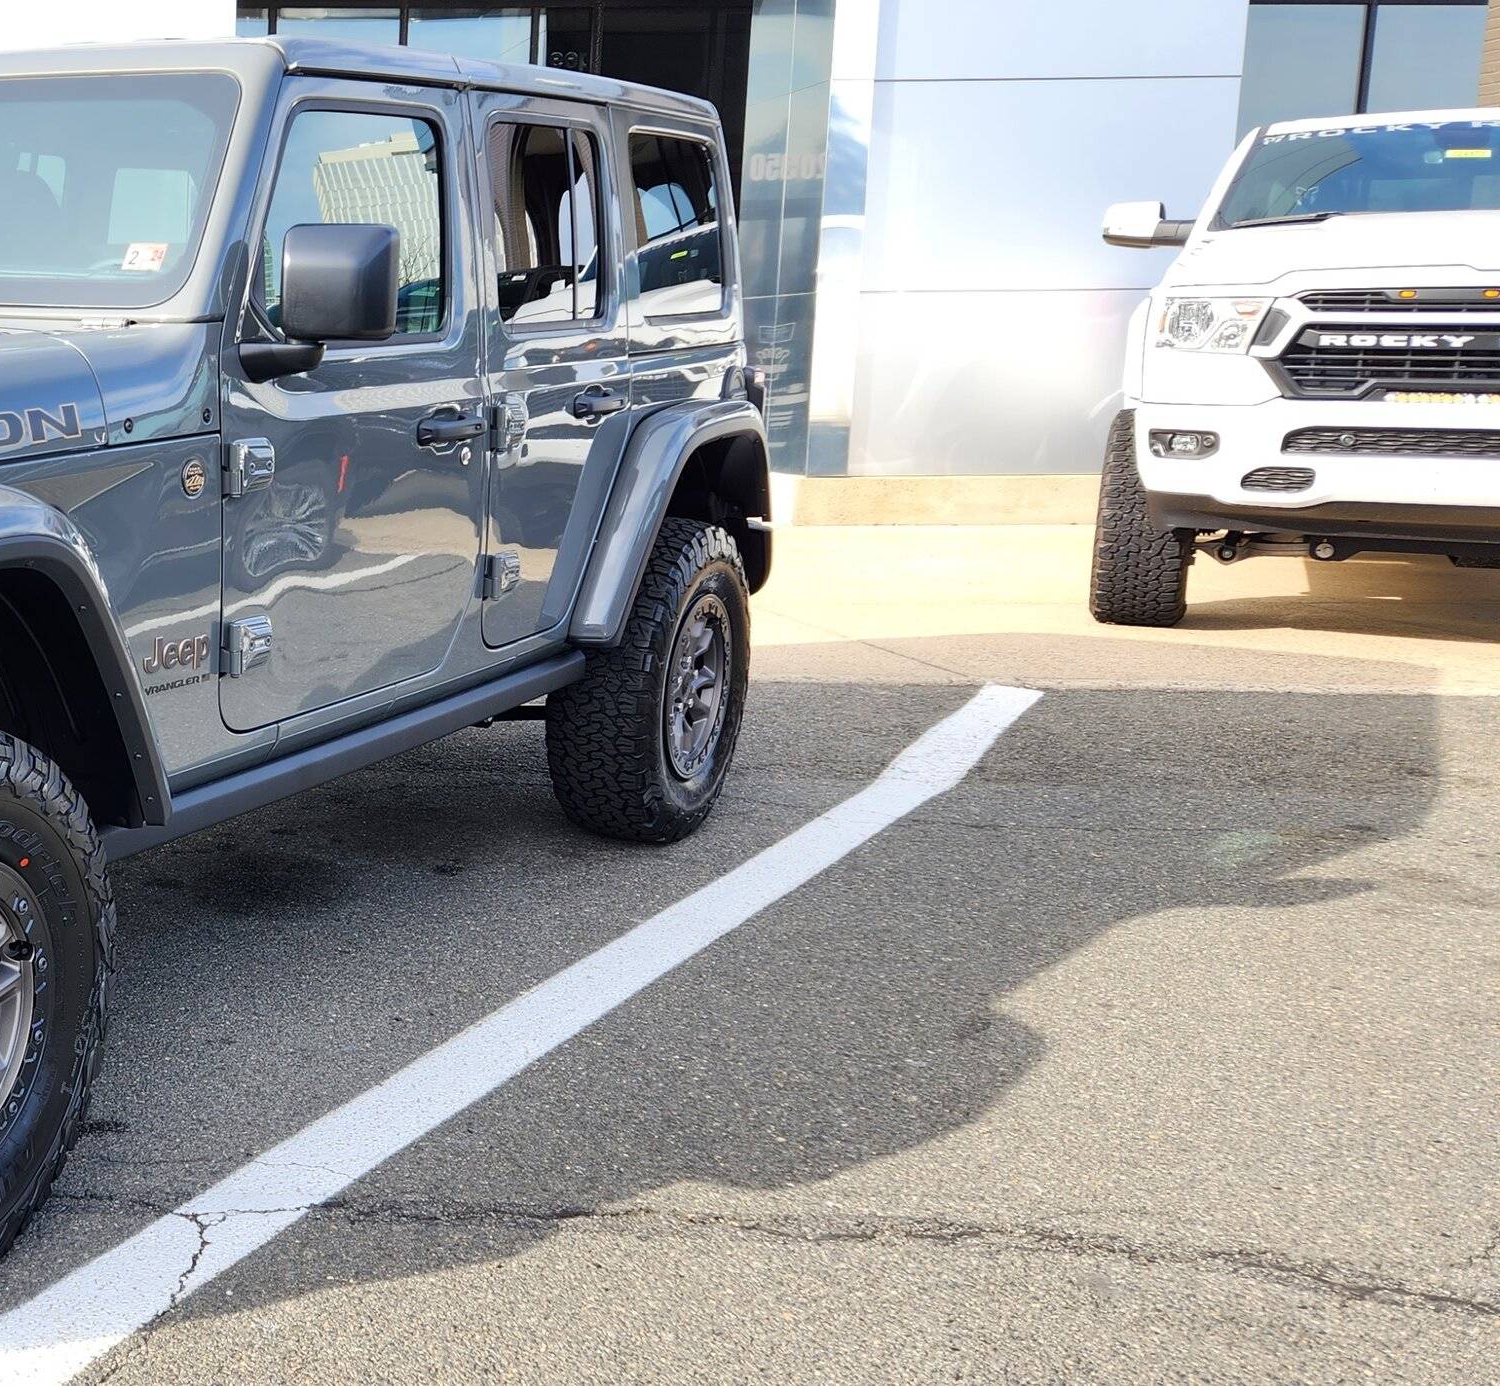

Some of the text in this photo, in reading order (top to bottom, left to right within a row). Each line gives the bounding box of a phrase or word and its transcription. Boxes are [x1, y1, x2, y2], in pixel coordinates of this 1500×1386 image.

[1288, 122, 1447, 140] ROCKY
[128, 250, 139, 264] 2
[1319, 334, 1475, 348] ROCKY
[143, 633, 210, 674] Jeep
